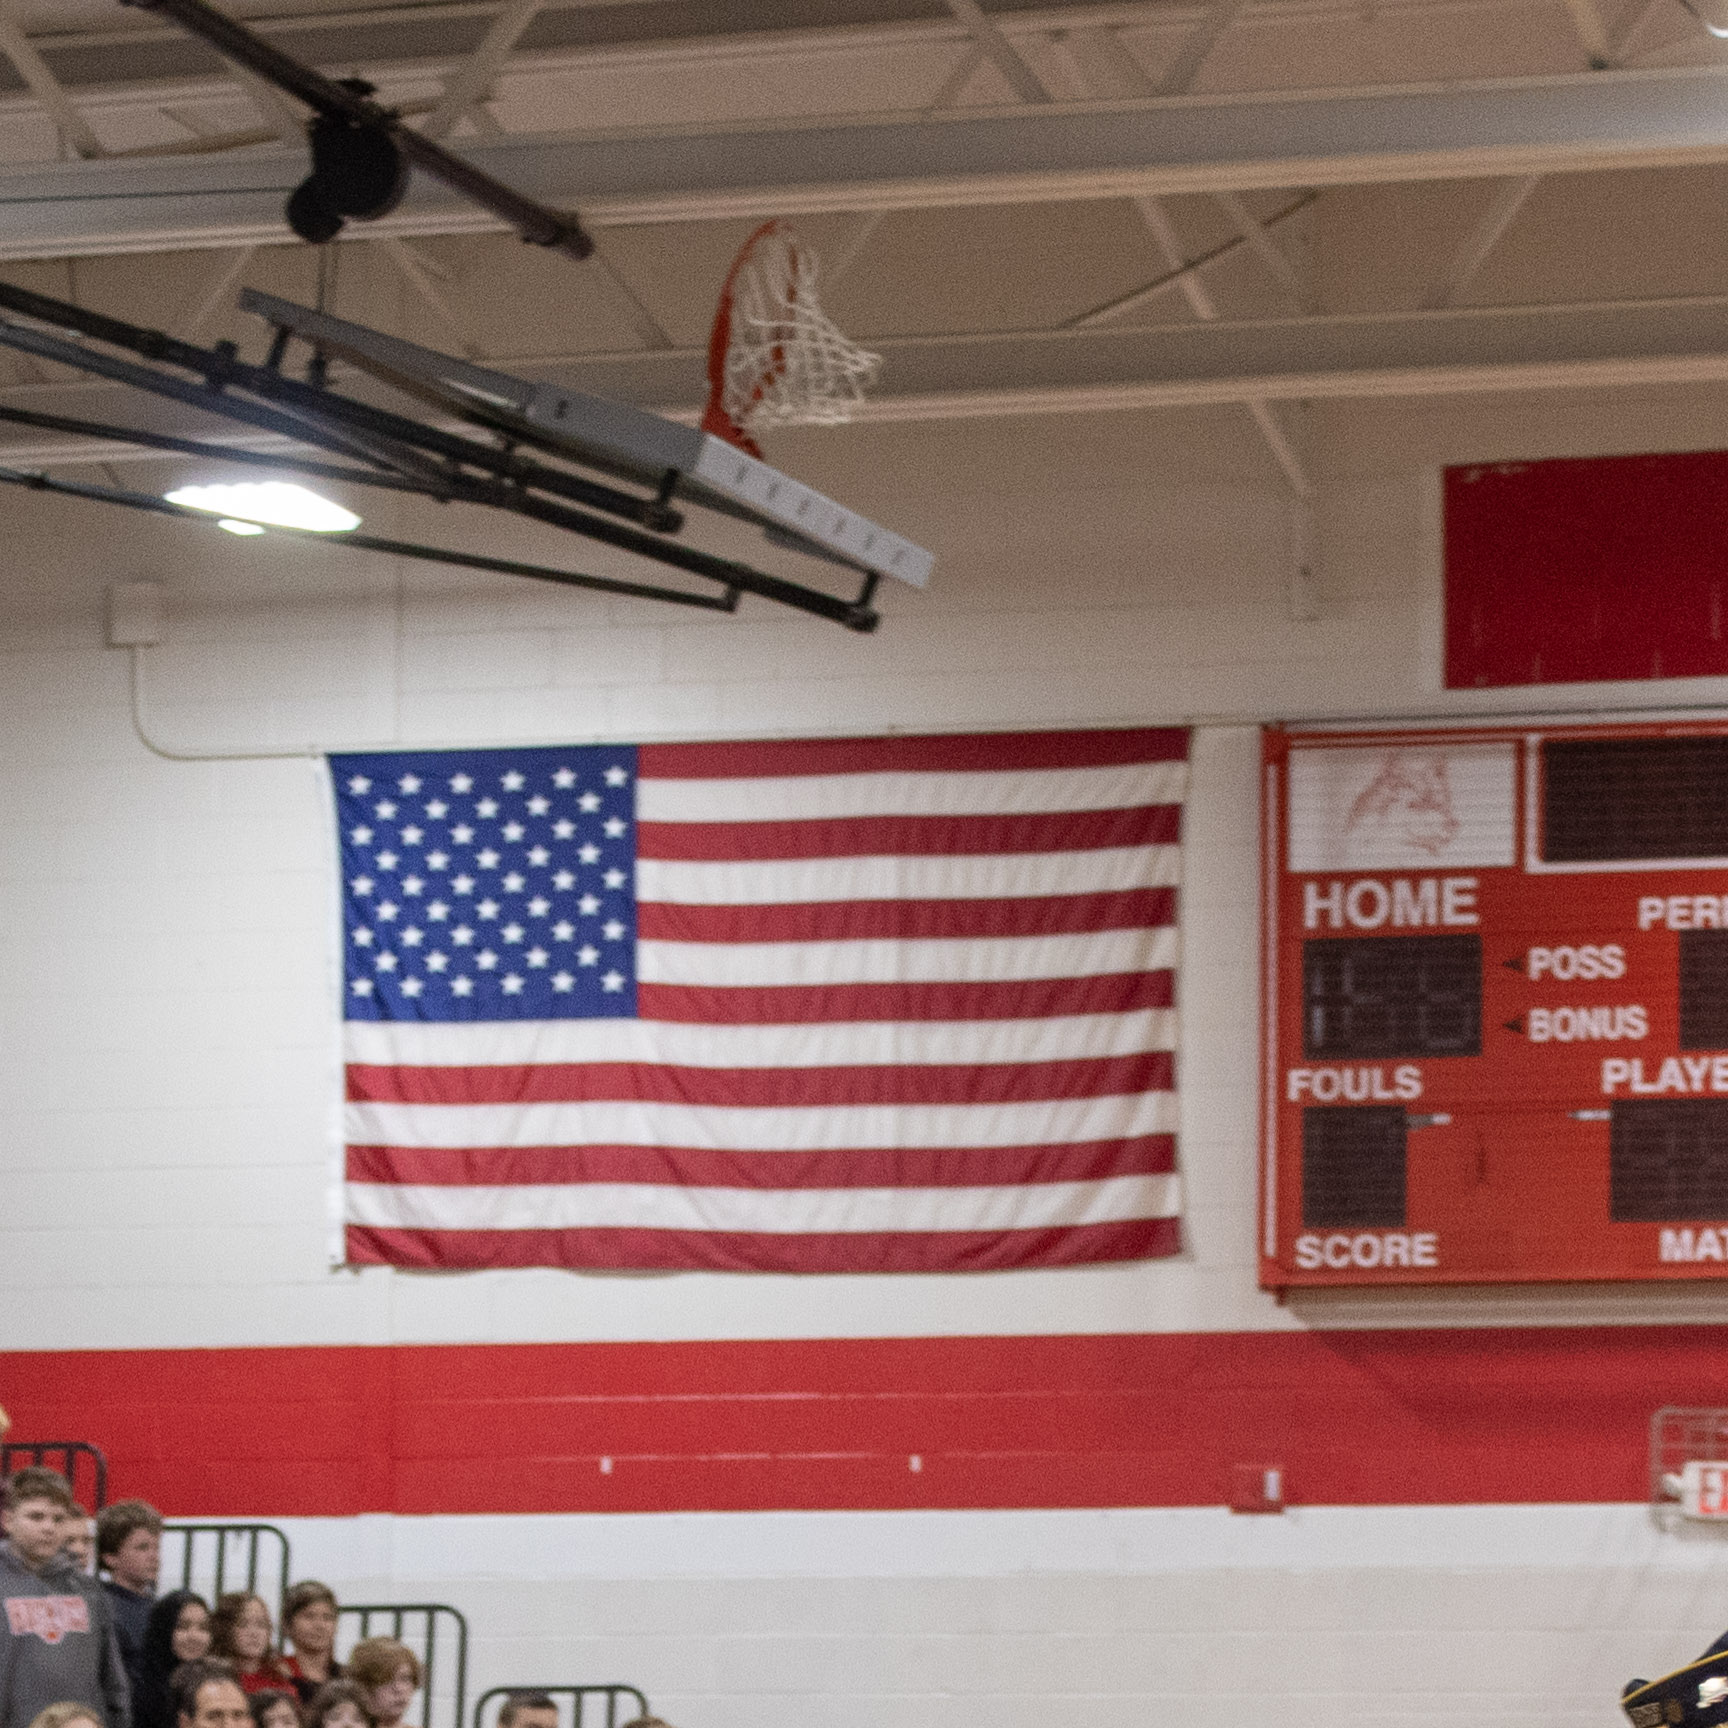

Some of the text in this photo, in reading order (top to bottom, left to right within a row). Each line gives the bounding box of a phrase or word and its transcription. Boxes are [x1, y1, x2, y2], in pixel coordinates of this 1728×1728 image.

[1305, 875, 1479, 929] HOME
[1531, 946, 1623, 978] POSS
[1531, 1007, 1646, 1040] BONUS
[1290, 1067, 1420, 1099] FOULS
[1298, 1234, 1435, 1267] SCORE
